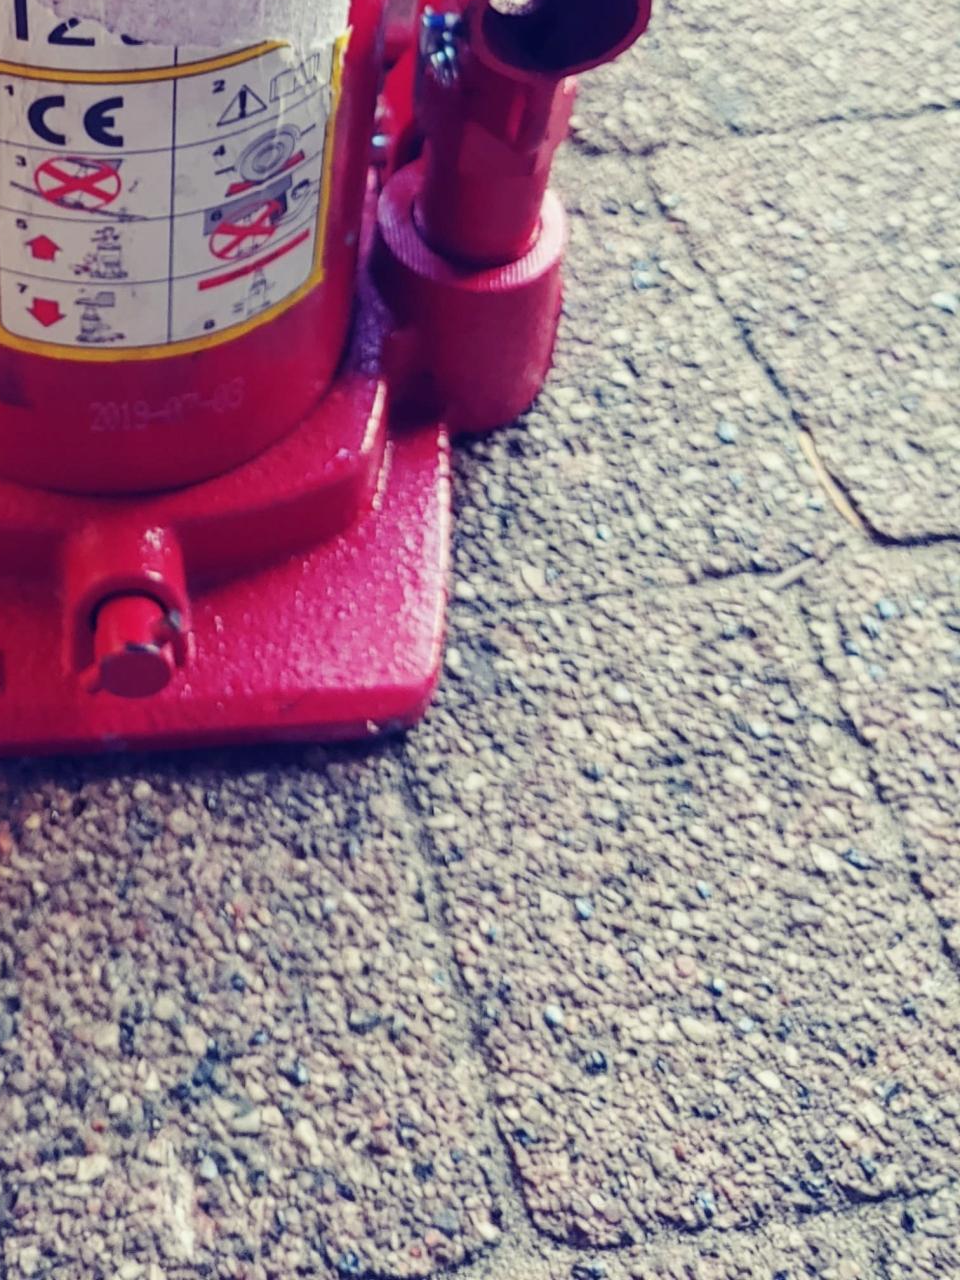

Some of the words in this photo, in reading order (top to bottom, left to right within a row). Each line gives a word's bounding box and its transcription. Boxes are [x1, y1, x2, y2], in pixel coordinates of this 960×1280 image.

[212, 79, 226, 94] 2
[27, 95, 125, 148] CE
[15, 155, 28, 168] 3
